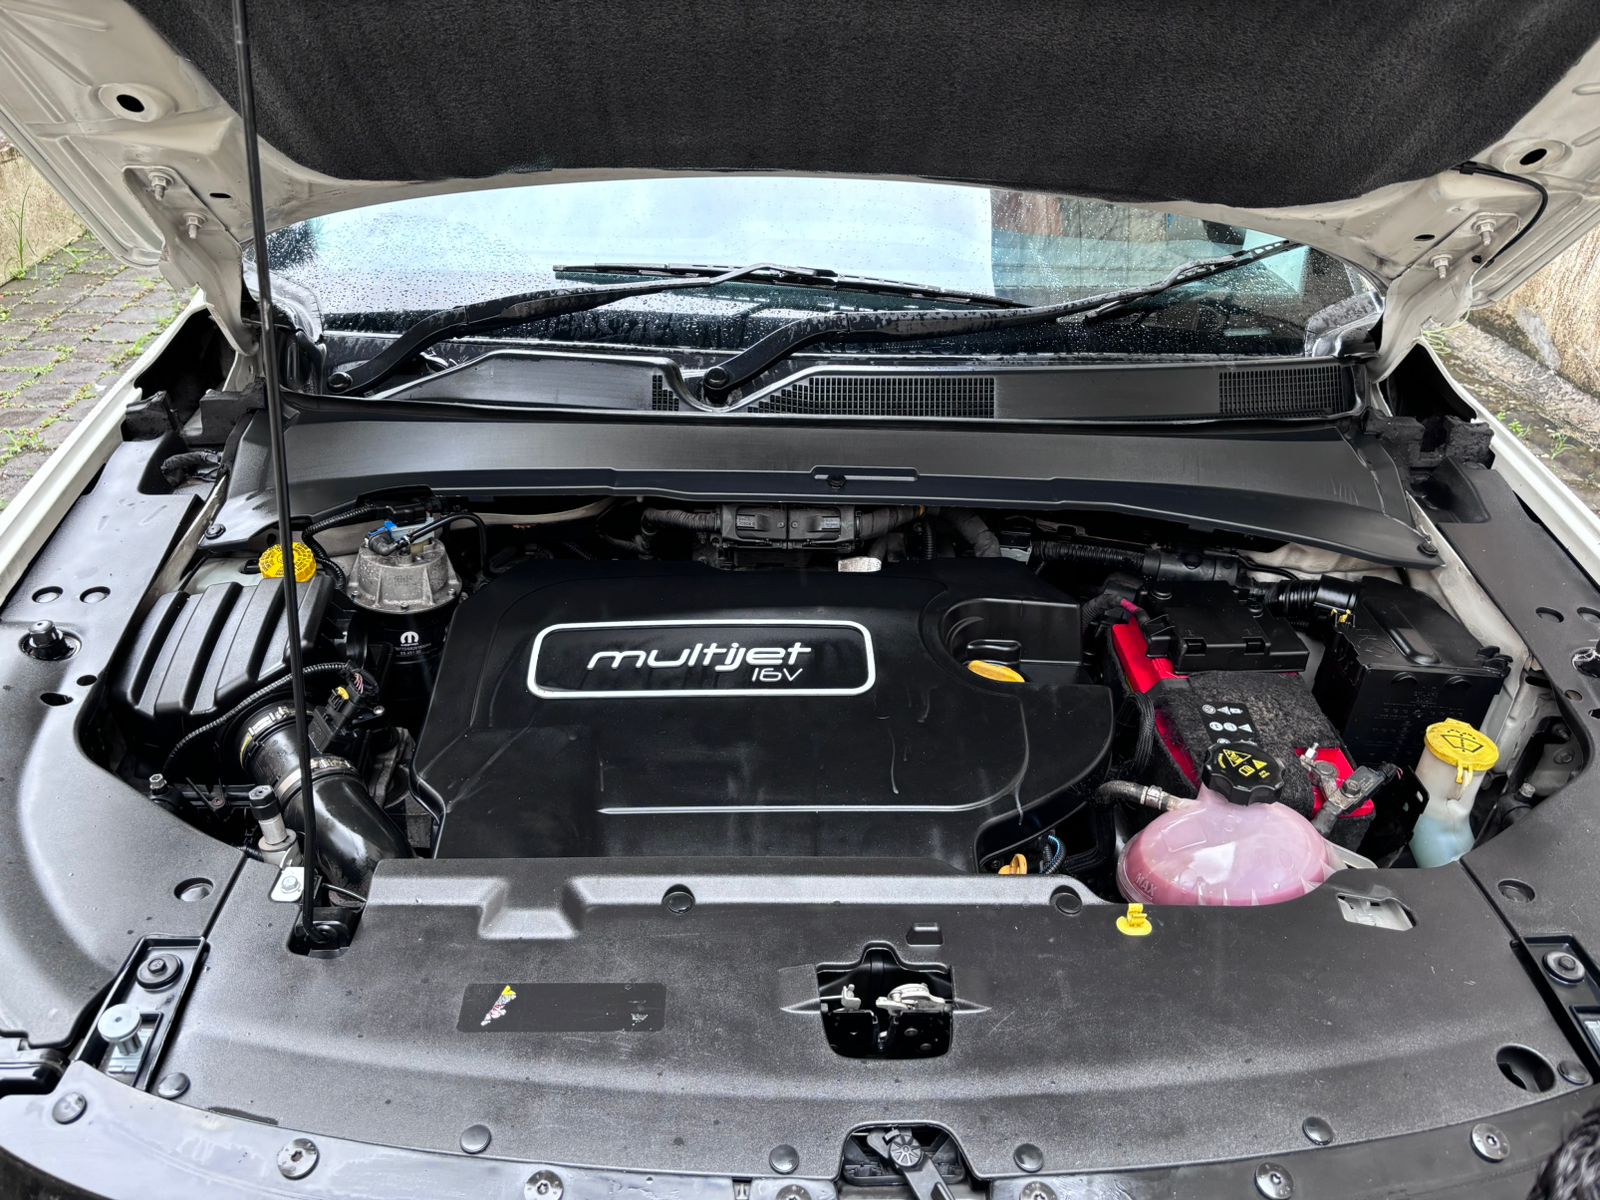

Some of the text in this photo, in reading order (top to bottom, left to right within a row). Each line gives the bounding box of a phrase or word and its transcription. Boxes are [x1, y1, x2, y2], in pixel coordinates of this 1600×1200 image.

[587, 642, 812, 672] multijet
[751, 667, 803, 682] 16V
[1135, 872, 1157, 897] MAX
